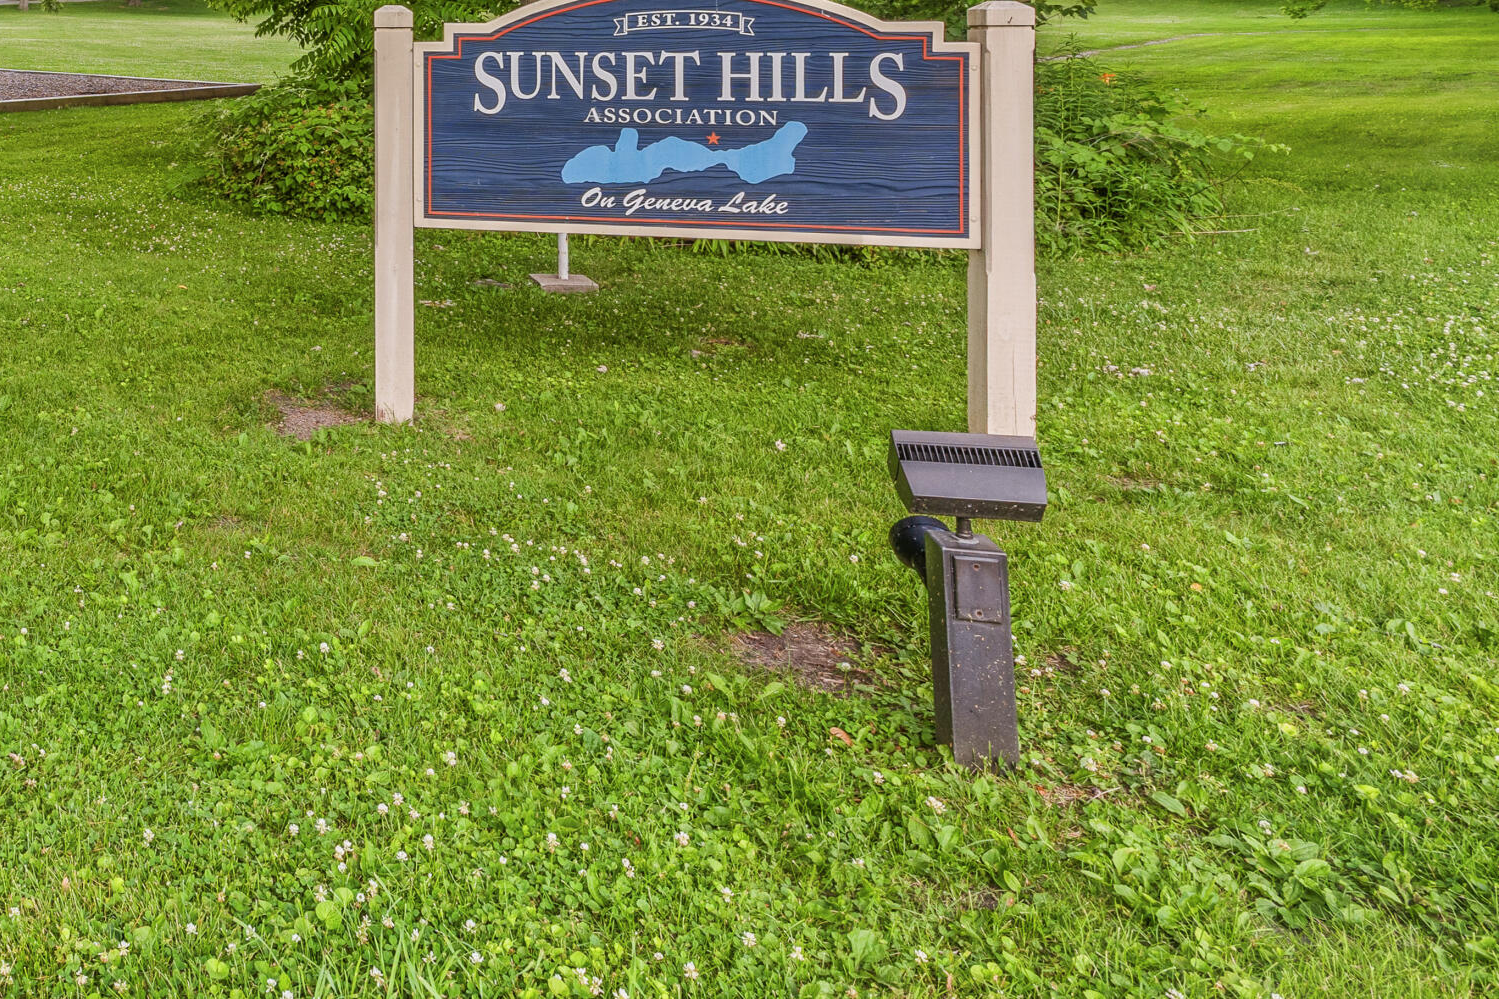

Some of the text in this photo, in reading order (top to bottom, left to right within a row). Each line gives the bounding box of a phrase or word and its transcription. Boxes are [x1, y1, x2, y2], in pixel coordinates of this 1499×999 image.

[637, 13, 734, 28] EST. 1934
[473, 50, 907, 121] SUNSET HILLS
[583, 107, 779, 127] ASSOCIATION
[580, 186, 789, 216] On Geneva Lake
